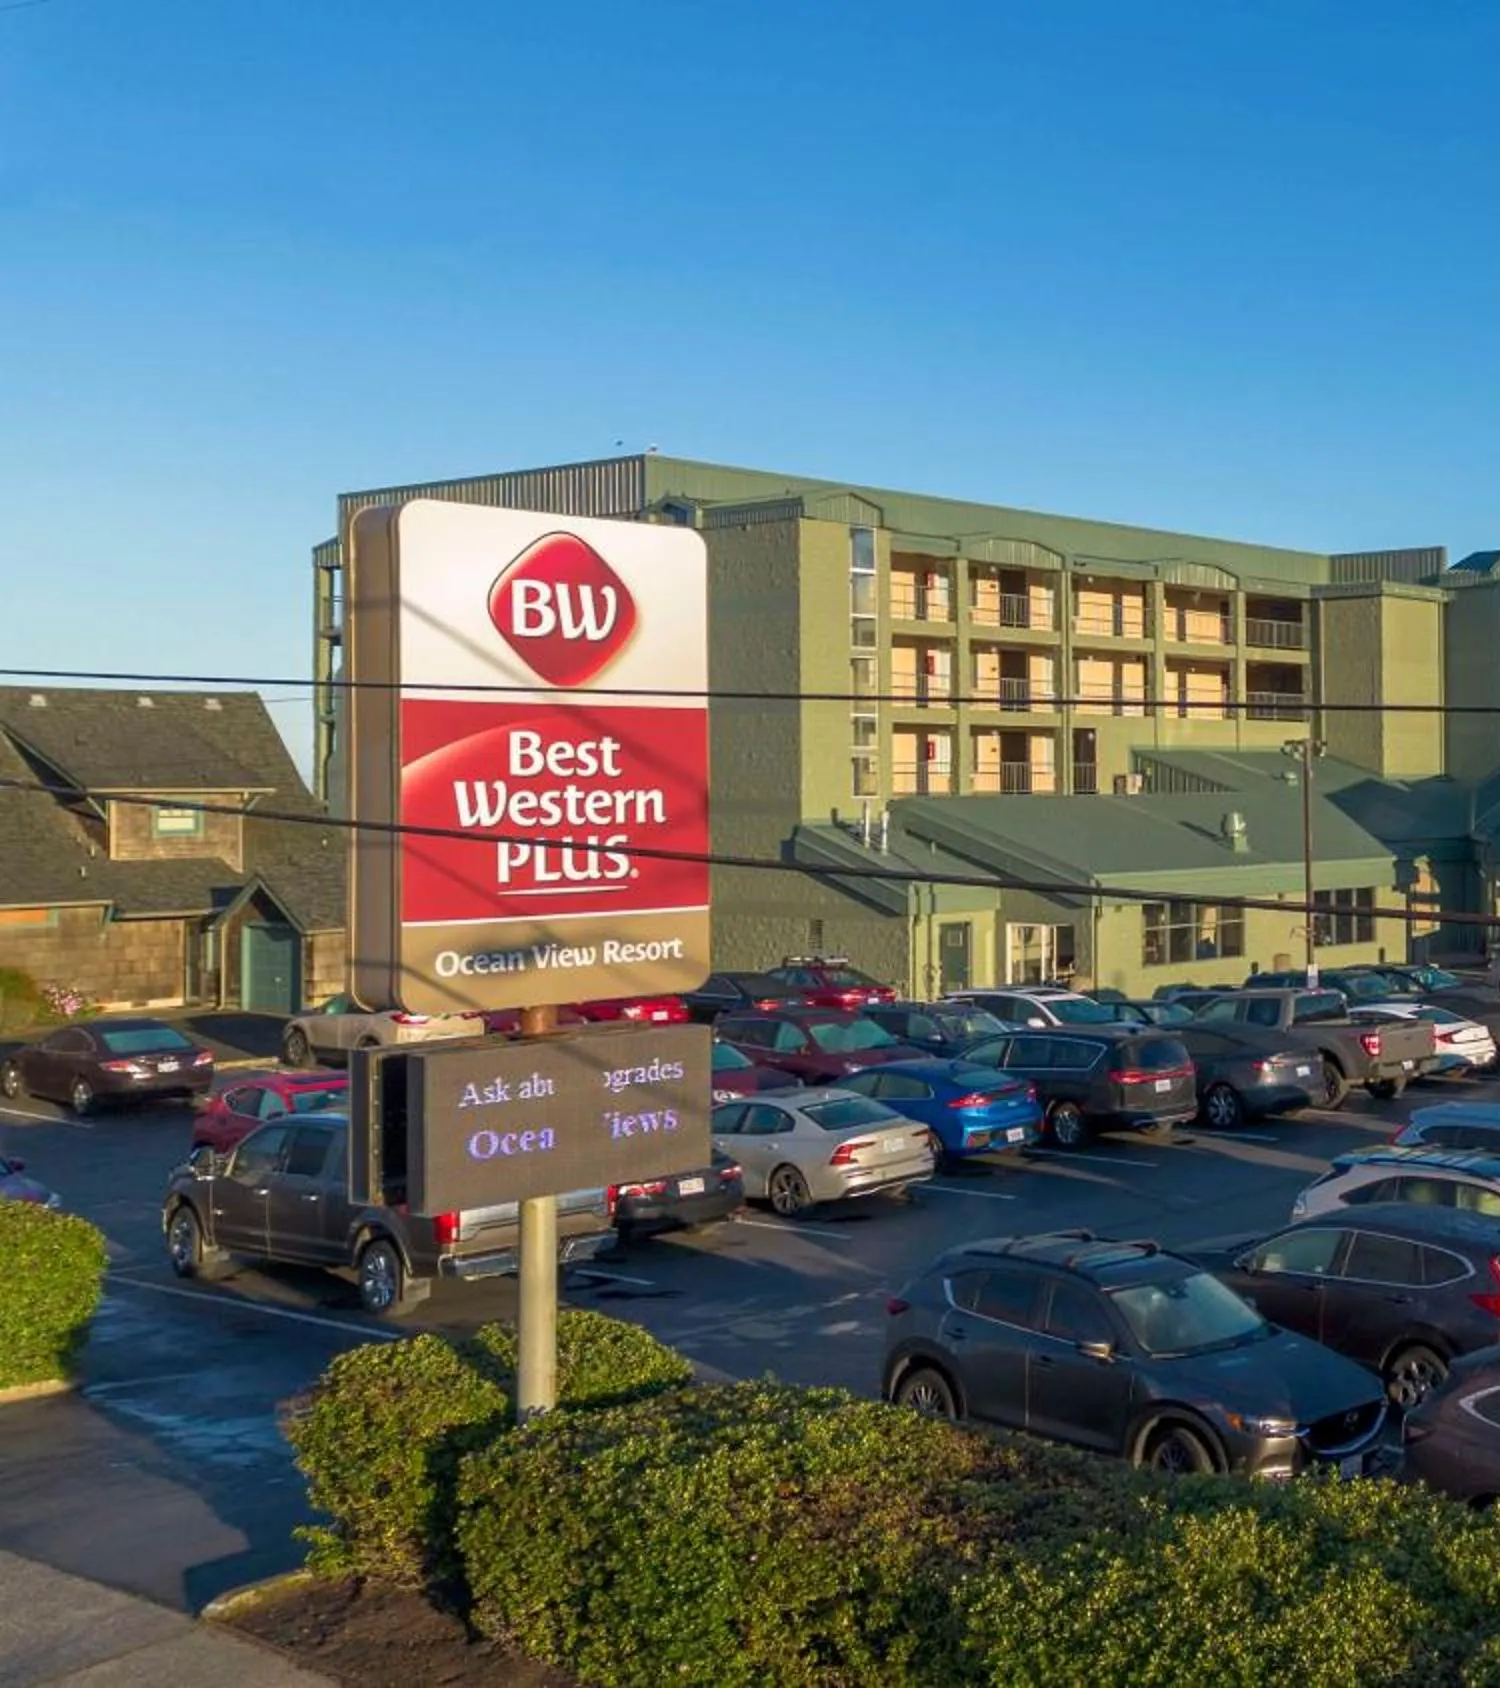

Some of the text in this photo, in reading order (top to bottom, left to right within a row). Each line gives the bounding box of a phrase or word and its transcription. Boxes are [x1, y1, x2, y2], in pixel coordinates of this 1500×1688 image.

[511, 579, 617, 641] BW
[509, 730, 623, 777] Best
[453, 779, 667, 828] Western
[434, 937, 684, 978] Ocean View Resort
[457, 1075, 513, 1109] Ask
[602, 1108, 680, 1140] iews
